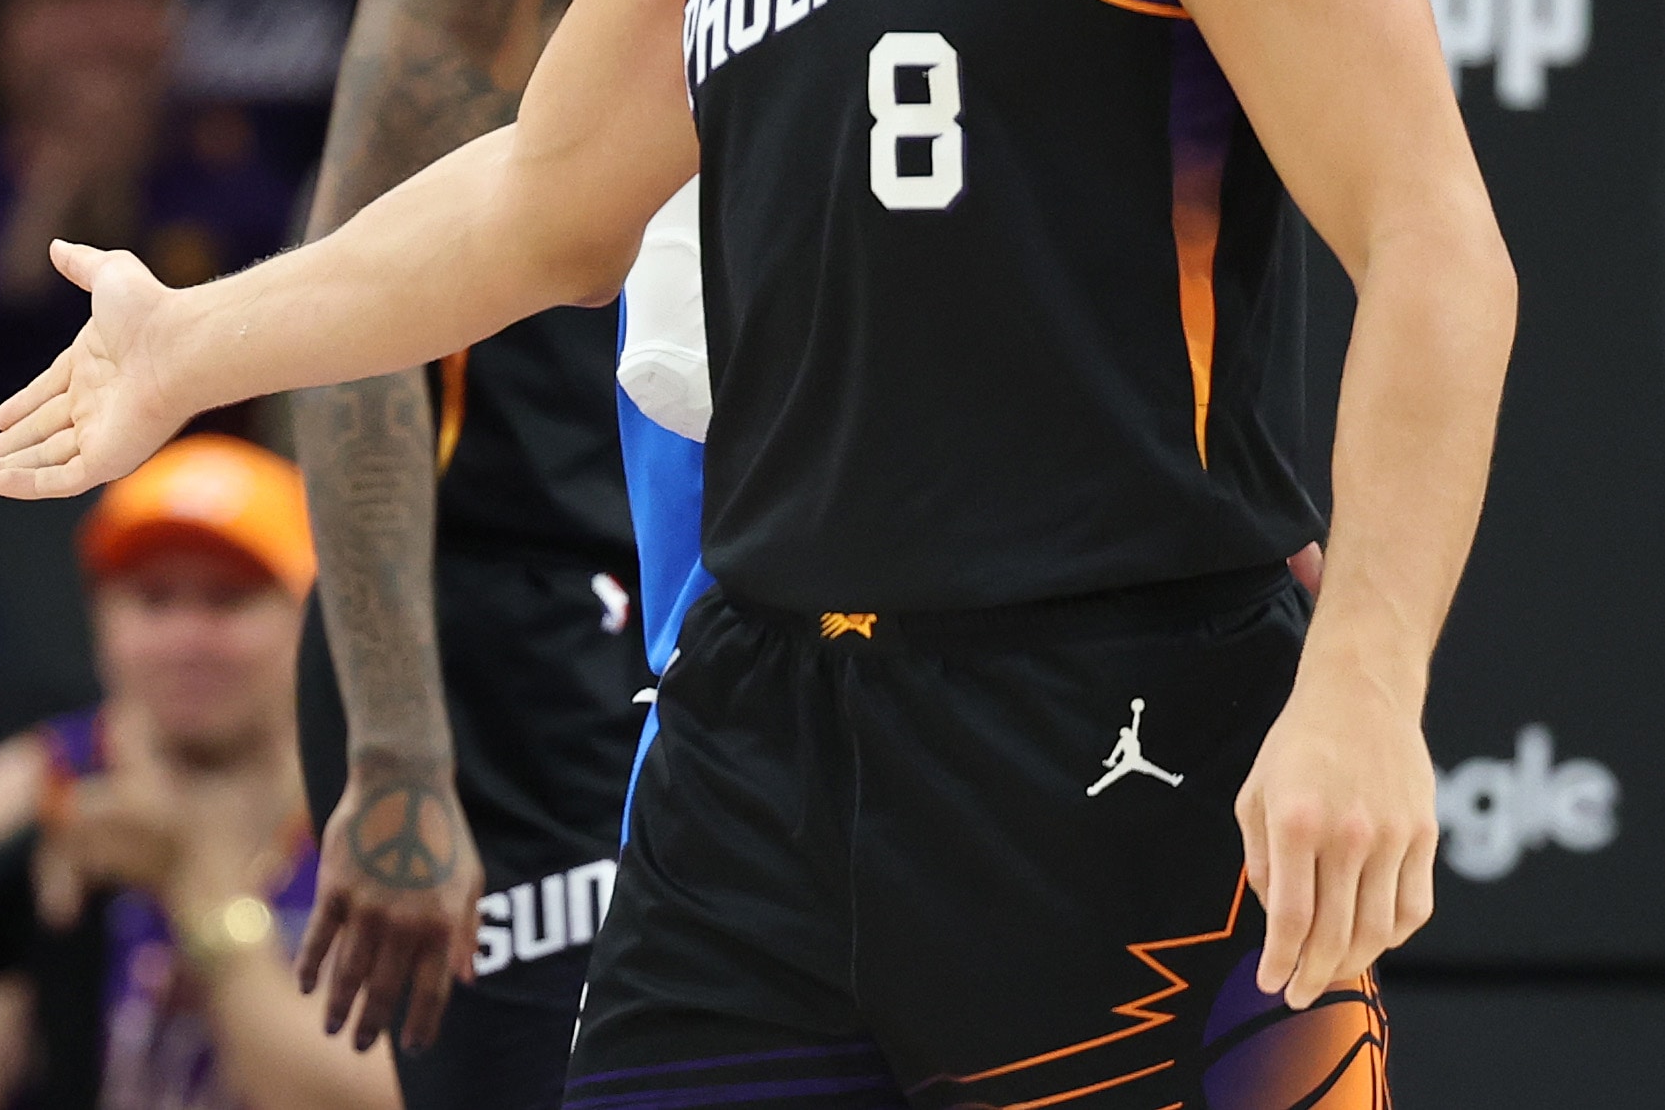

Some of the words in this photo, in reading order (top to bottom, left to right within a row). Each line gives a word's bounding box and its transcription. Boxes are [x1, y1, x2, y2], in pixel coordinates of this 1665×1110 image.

[869, 32, 964, 210] 8
[1434, 723, 1621, 881] gle
[472, 858, 618, 976] SUN
